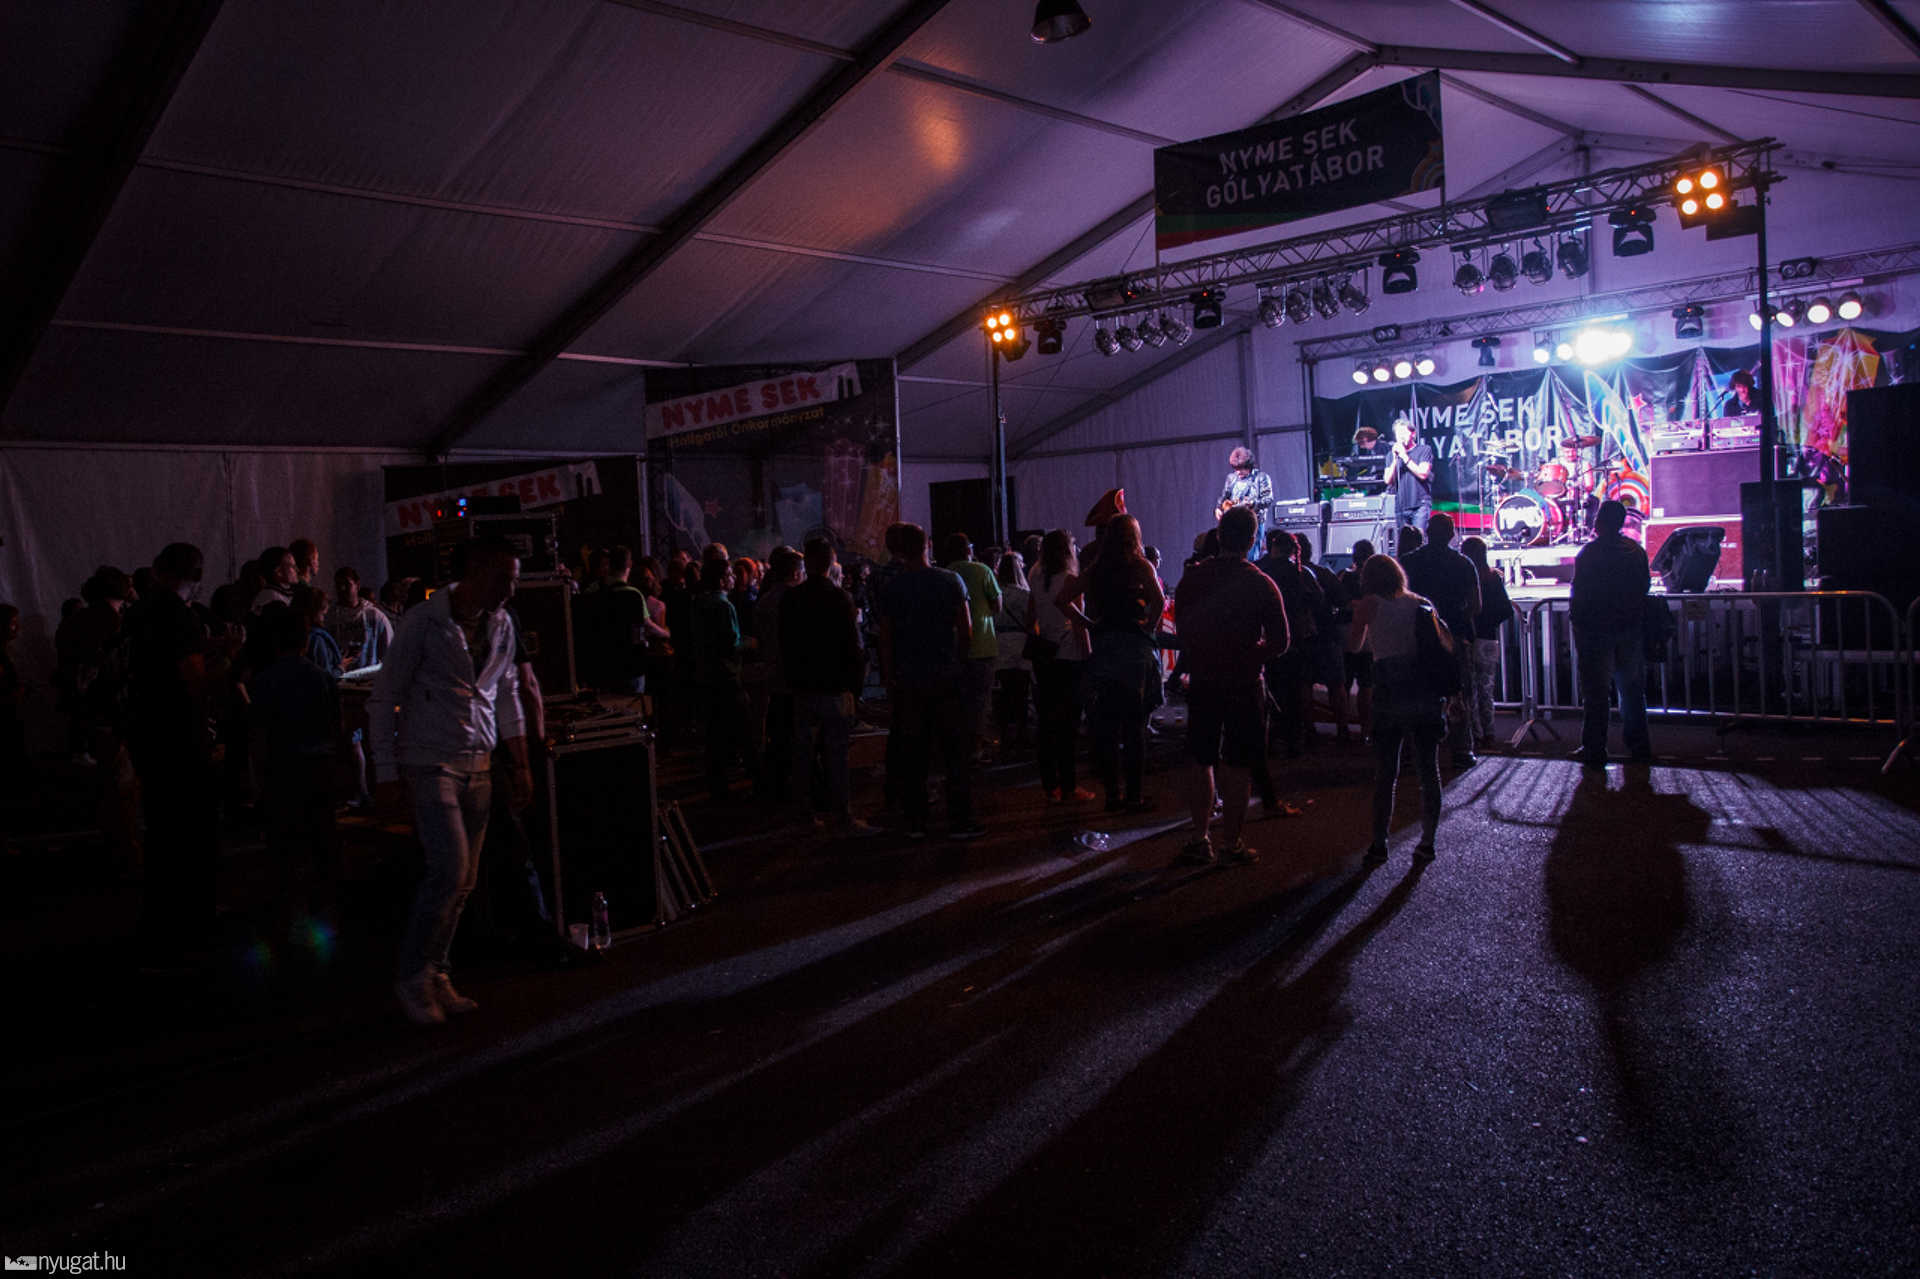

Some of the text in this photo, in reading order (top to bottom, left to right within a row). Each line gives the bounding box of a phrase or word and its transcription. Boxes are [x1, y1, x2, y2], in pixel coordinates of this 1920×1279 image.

[1219, 118, 1358, 175] NYME SEK
[1206, 145, 1385, 208] GÓLYATÁBOR
[662, 377, 821, 428] NYME SEK
[1481, 396, 1536, 424] SEK
